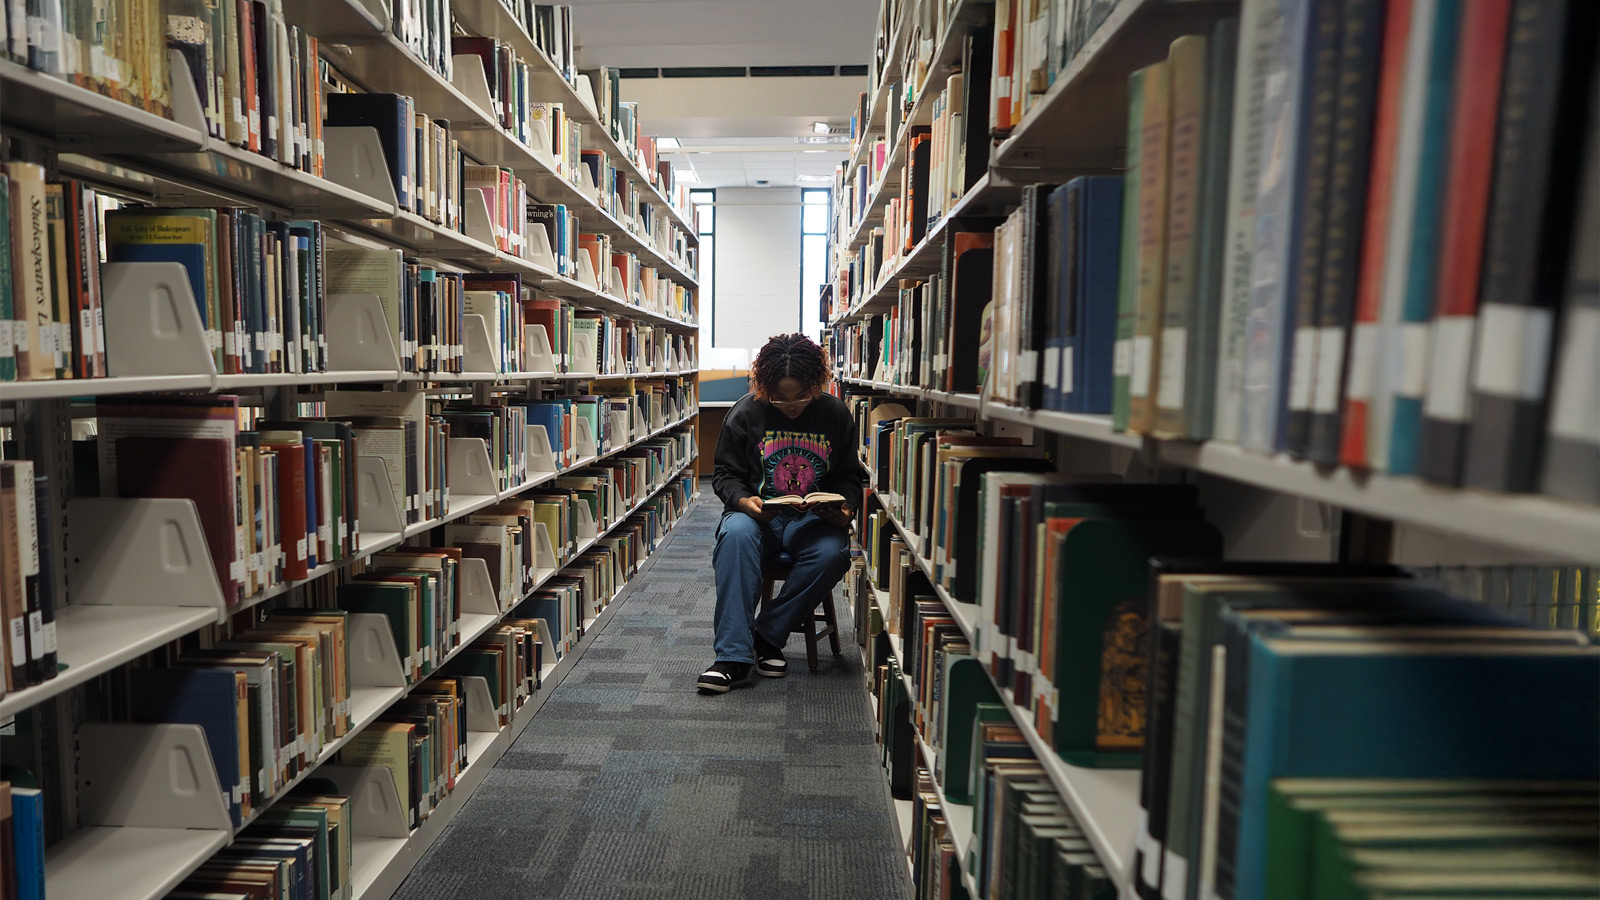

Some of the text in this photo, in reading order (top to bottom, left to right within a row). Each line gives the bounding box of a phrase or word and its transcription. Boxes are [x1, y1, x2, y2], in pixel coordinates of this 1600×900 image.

[157, 224, 192, 235] Shakespeare
[526, 209, 554, 219] wning's
[31, 195, 48, 306] Shakespeare's
[764, 430, 828, 461] SANTANA
[8, 500, 22, 605] SHAKESPEARE
[28, 470, 38, 570] CONTESTED WILL
